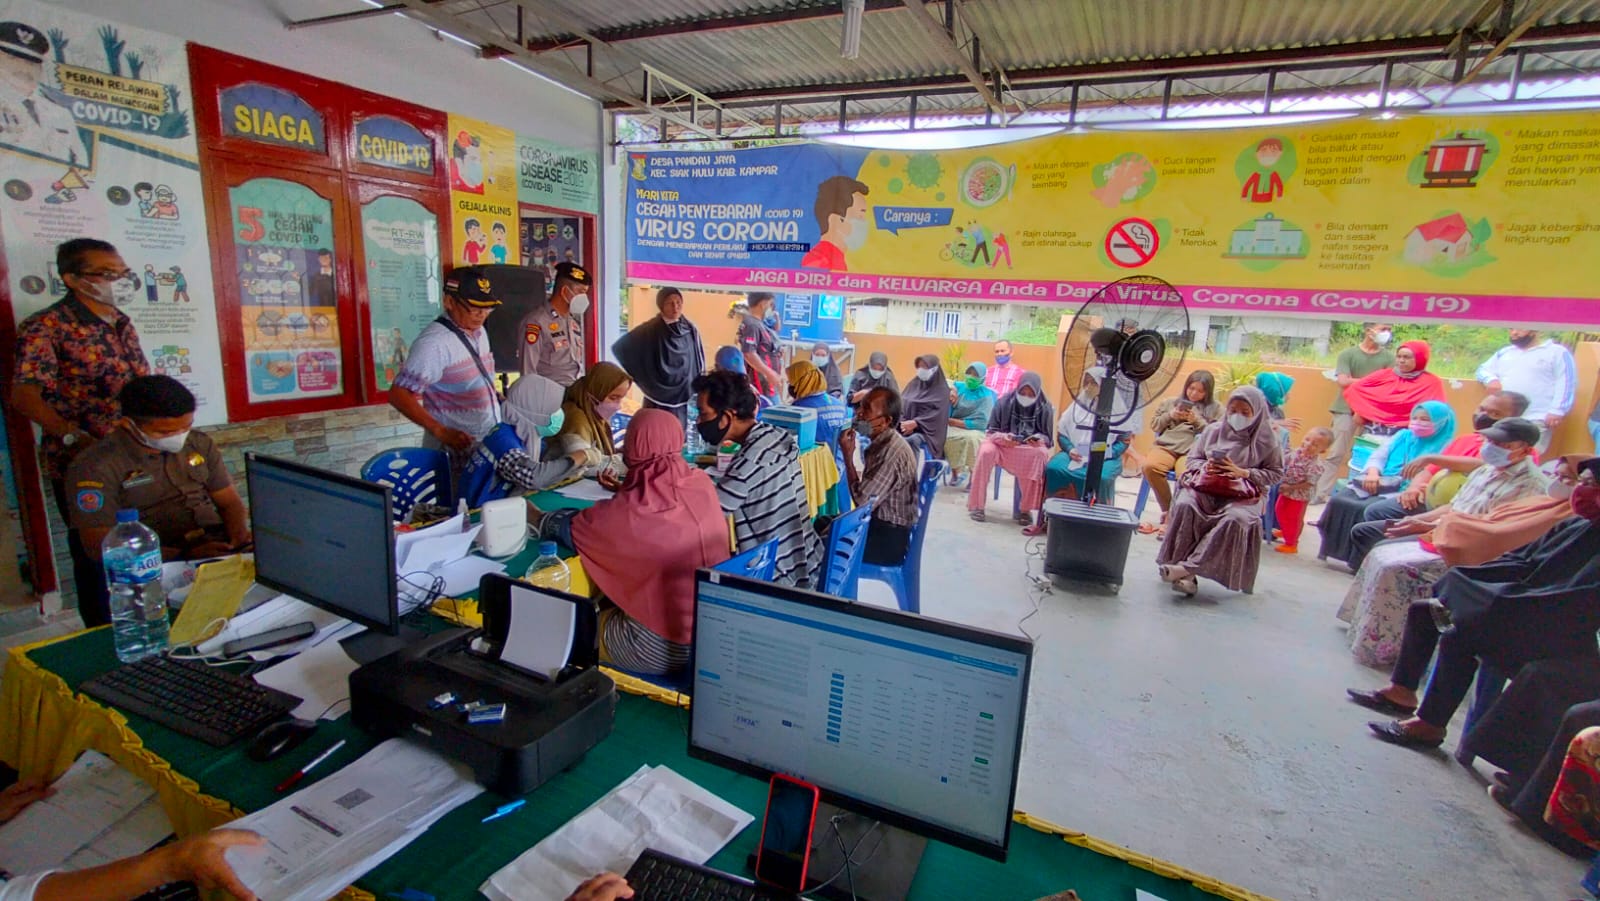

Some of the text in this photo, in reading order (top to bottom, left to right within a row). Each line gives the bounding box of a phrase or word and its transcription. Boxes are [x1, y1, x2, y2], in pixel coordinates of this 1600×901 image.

[65, 71, 159, 98] PERAN RELAWAN
[73, 87, 108, 101] DALAM
[72, 101, 161, 131] COVID-19
[234, 104, 315, 146] SIAGA
[1311, 130, 1400, 143] Gunakan masker
[1517, 129, 1559, 139] Makan
[360, 134, 430, 169] COVID-19
[1308, 143, 1384, 154] bila batuk atau
[1513, 143, 1544, 154] yang
[519, 145, 589, 174] CORONAVIRUS
[650, 154, 737, 167] DESA PANDAU JAYA
[1032, 160, 1089, 170] Makan dengan
[1163, 156, 1216, 166] Cuci tangan
[1306, 153, 1406, 165] tutup mulut dengan
[1510, 154, 1534, 164] dan
[1536, 154, 1579, 164] jangan
[520, 163, 563, 184] DISEASE
[562, 171, 584, 188] 2019
[669, 168, 690, 178] SIAK
[691, 167, 715, 177] HULU
[739, 165, 779, 176] KAMPAR
[1047, 171, 1066, 180] yang
[1161, 167, 1215, 176] pakai sabun
[1305, 166, 1363, 176] lengan atas
[1534, 166, 1575, 175] hewan
[521, 179, 554, 194] (COVID-19)
[1031, 181, 1068, 189] seimbang
[1303, 176, 1370, 188] bagian dalam
[1504, 177, 1577, 187] menularkan
[635, 188, 660, 201] MARI
[459, 200, 512, 217] GEJALA KLINIS
[636, 202, 804, 219] CEGAH PENYEBARAN (COVID 19)
[883, 208, 931, 225] Caranya
[238, 205, 266, 242] 5
[273, 219, 314, 234] CEGAH
[635, 218, 799, 241] VIRUS CORONA
[1326, 222, 1389, 231] Bila demam
[1507, 223, 1536, 233] Jaga
[391, 227, 424, 239] RT-RW
[1022, 230, 1077, 239] Rajin olahraga
[1183, 227, 1205, 237] Tidak
[1324, 233, 1377, 241] dan sesak
[637, 239, 665, 248] DENGAN
[665, 240, 712, 250] MENERAPKAN
[713, 242, 746, 251] PERILAKU
[751, 243, 774, 251] HIDUP
[1022, 239, 1093, 249] dan istirahat cukup
[1180, 238, 1217, 247] Merokok
[1504, 234, 1570, 246] lingkungan
[1321, 243, 1389, 252] nafas segera
[687, 250, 703, 258] DAN
[1320, 252, 1375, 261] ke fasilitas
[1318, 262, 1371, 271] kesehatan
[745, 269, 1471, 313] JAGA DIRI dan KELUARGA Anda Dari Virus Corona (Covid 19)
